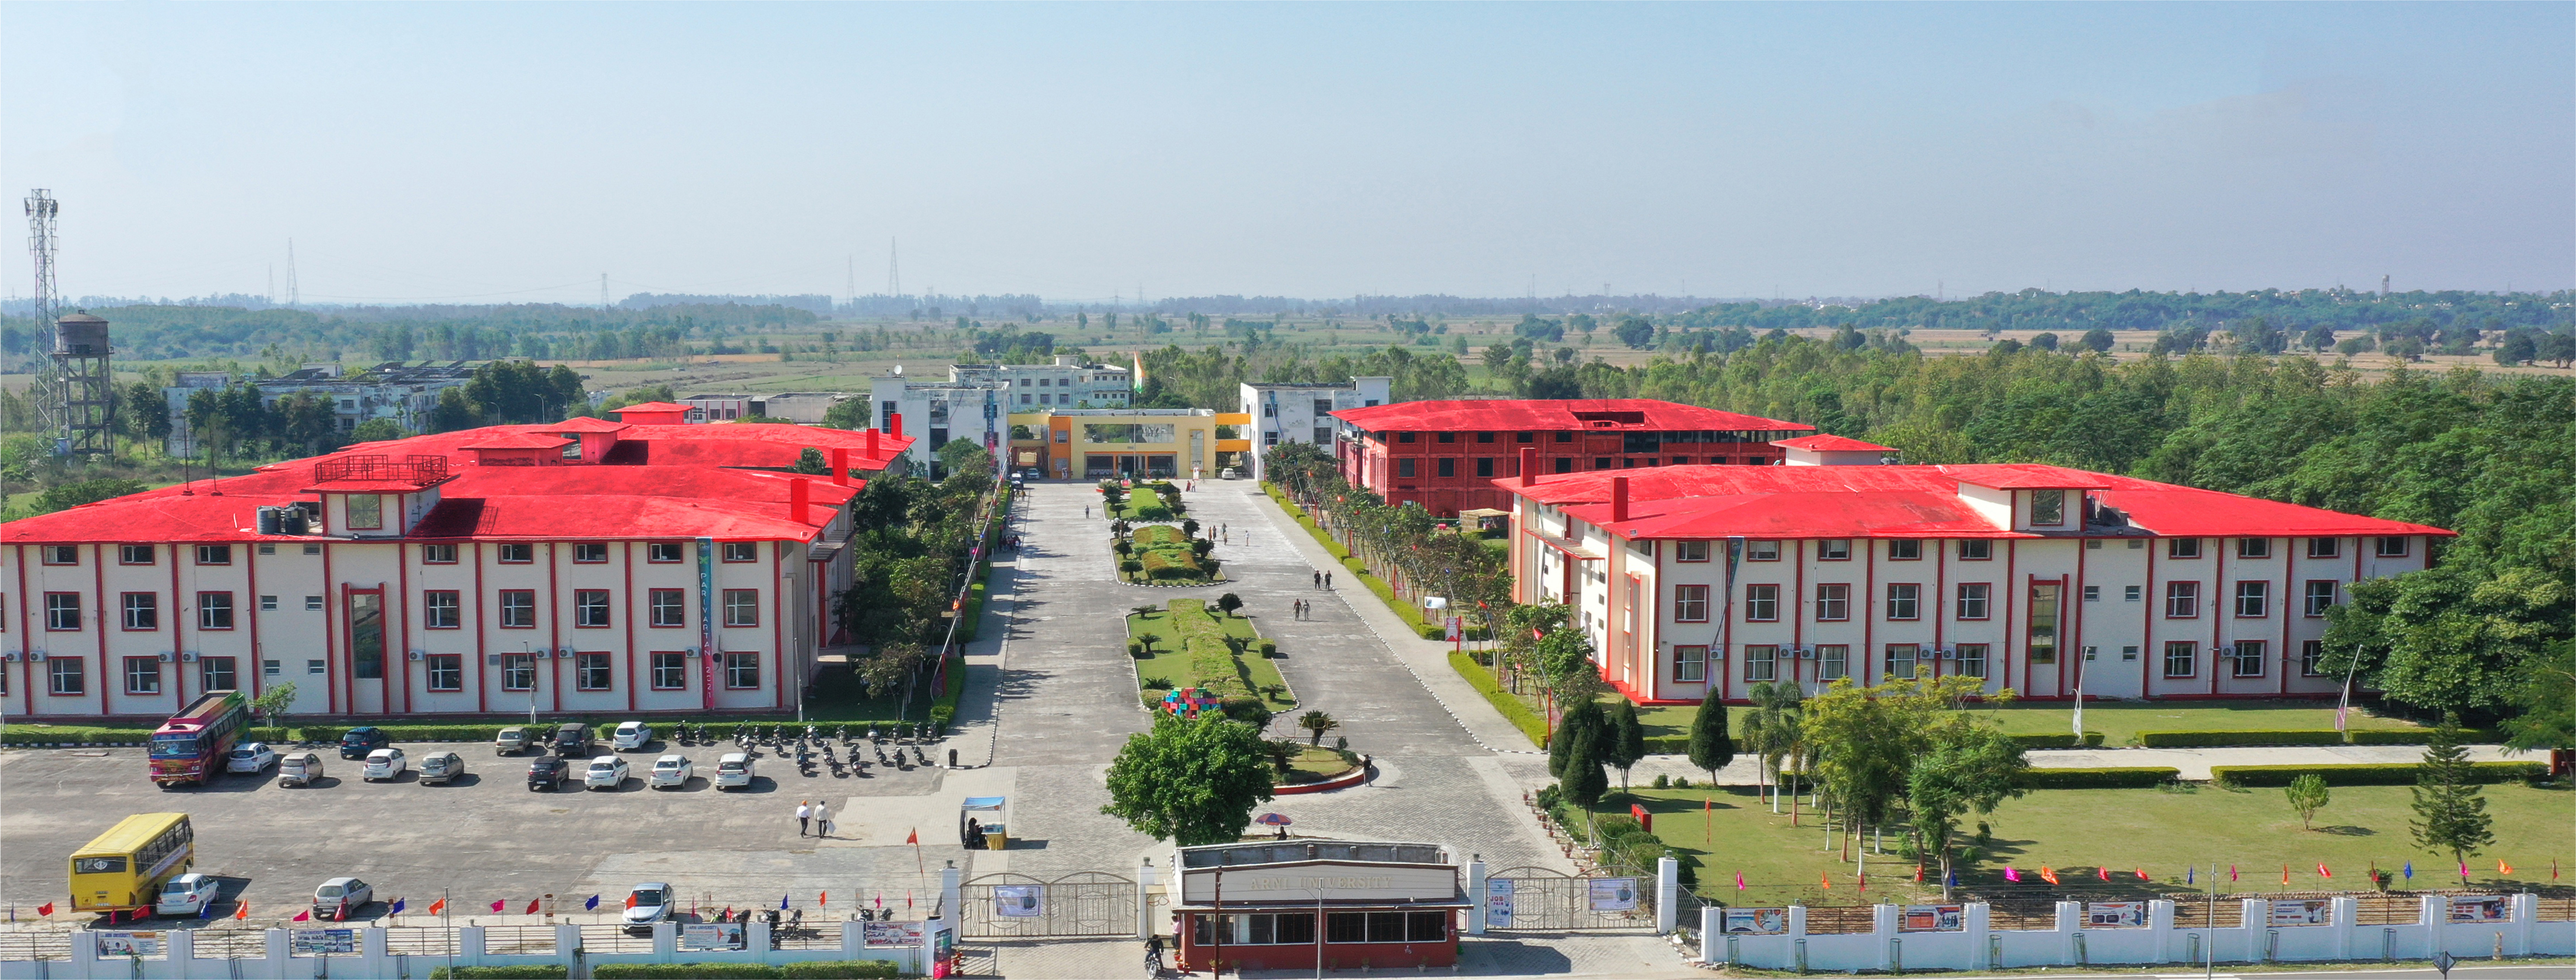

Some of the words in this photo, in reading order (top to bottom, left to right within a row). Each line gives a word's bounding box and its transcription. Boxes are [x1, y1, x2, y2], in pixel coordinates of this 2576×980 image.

[701, 573, 710, 656] PARIVARTAN
[1251, 877, 1288, 890] ARNI
[1299, 876, 1392, 889] UNVERSITY
